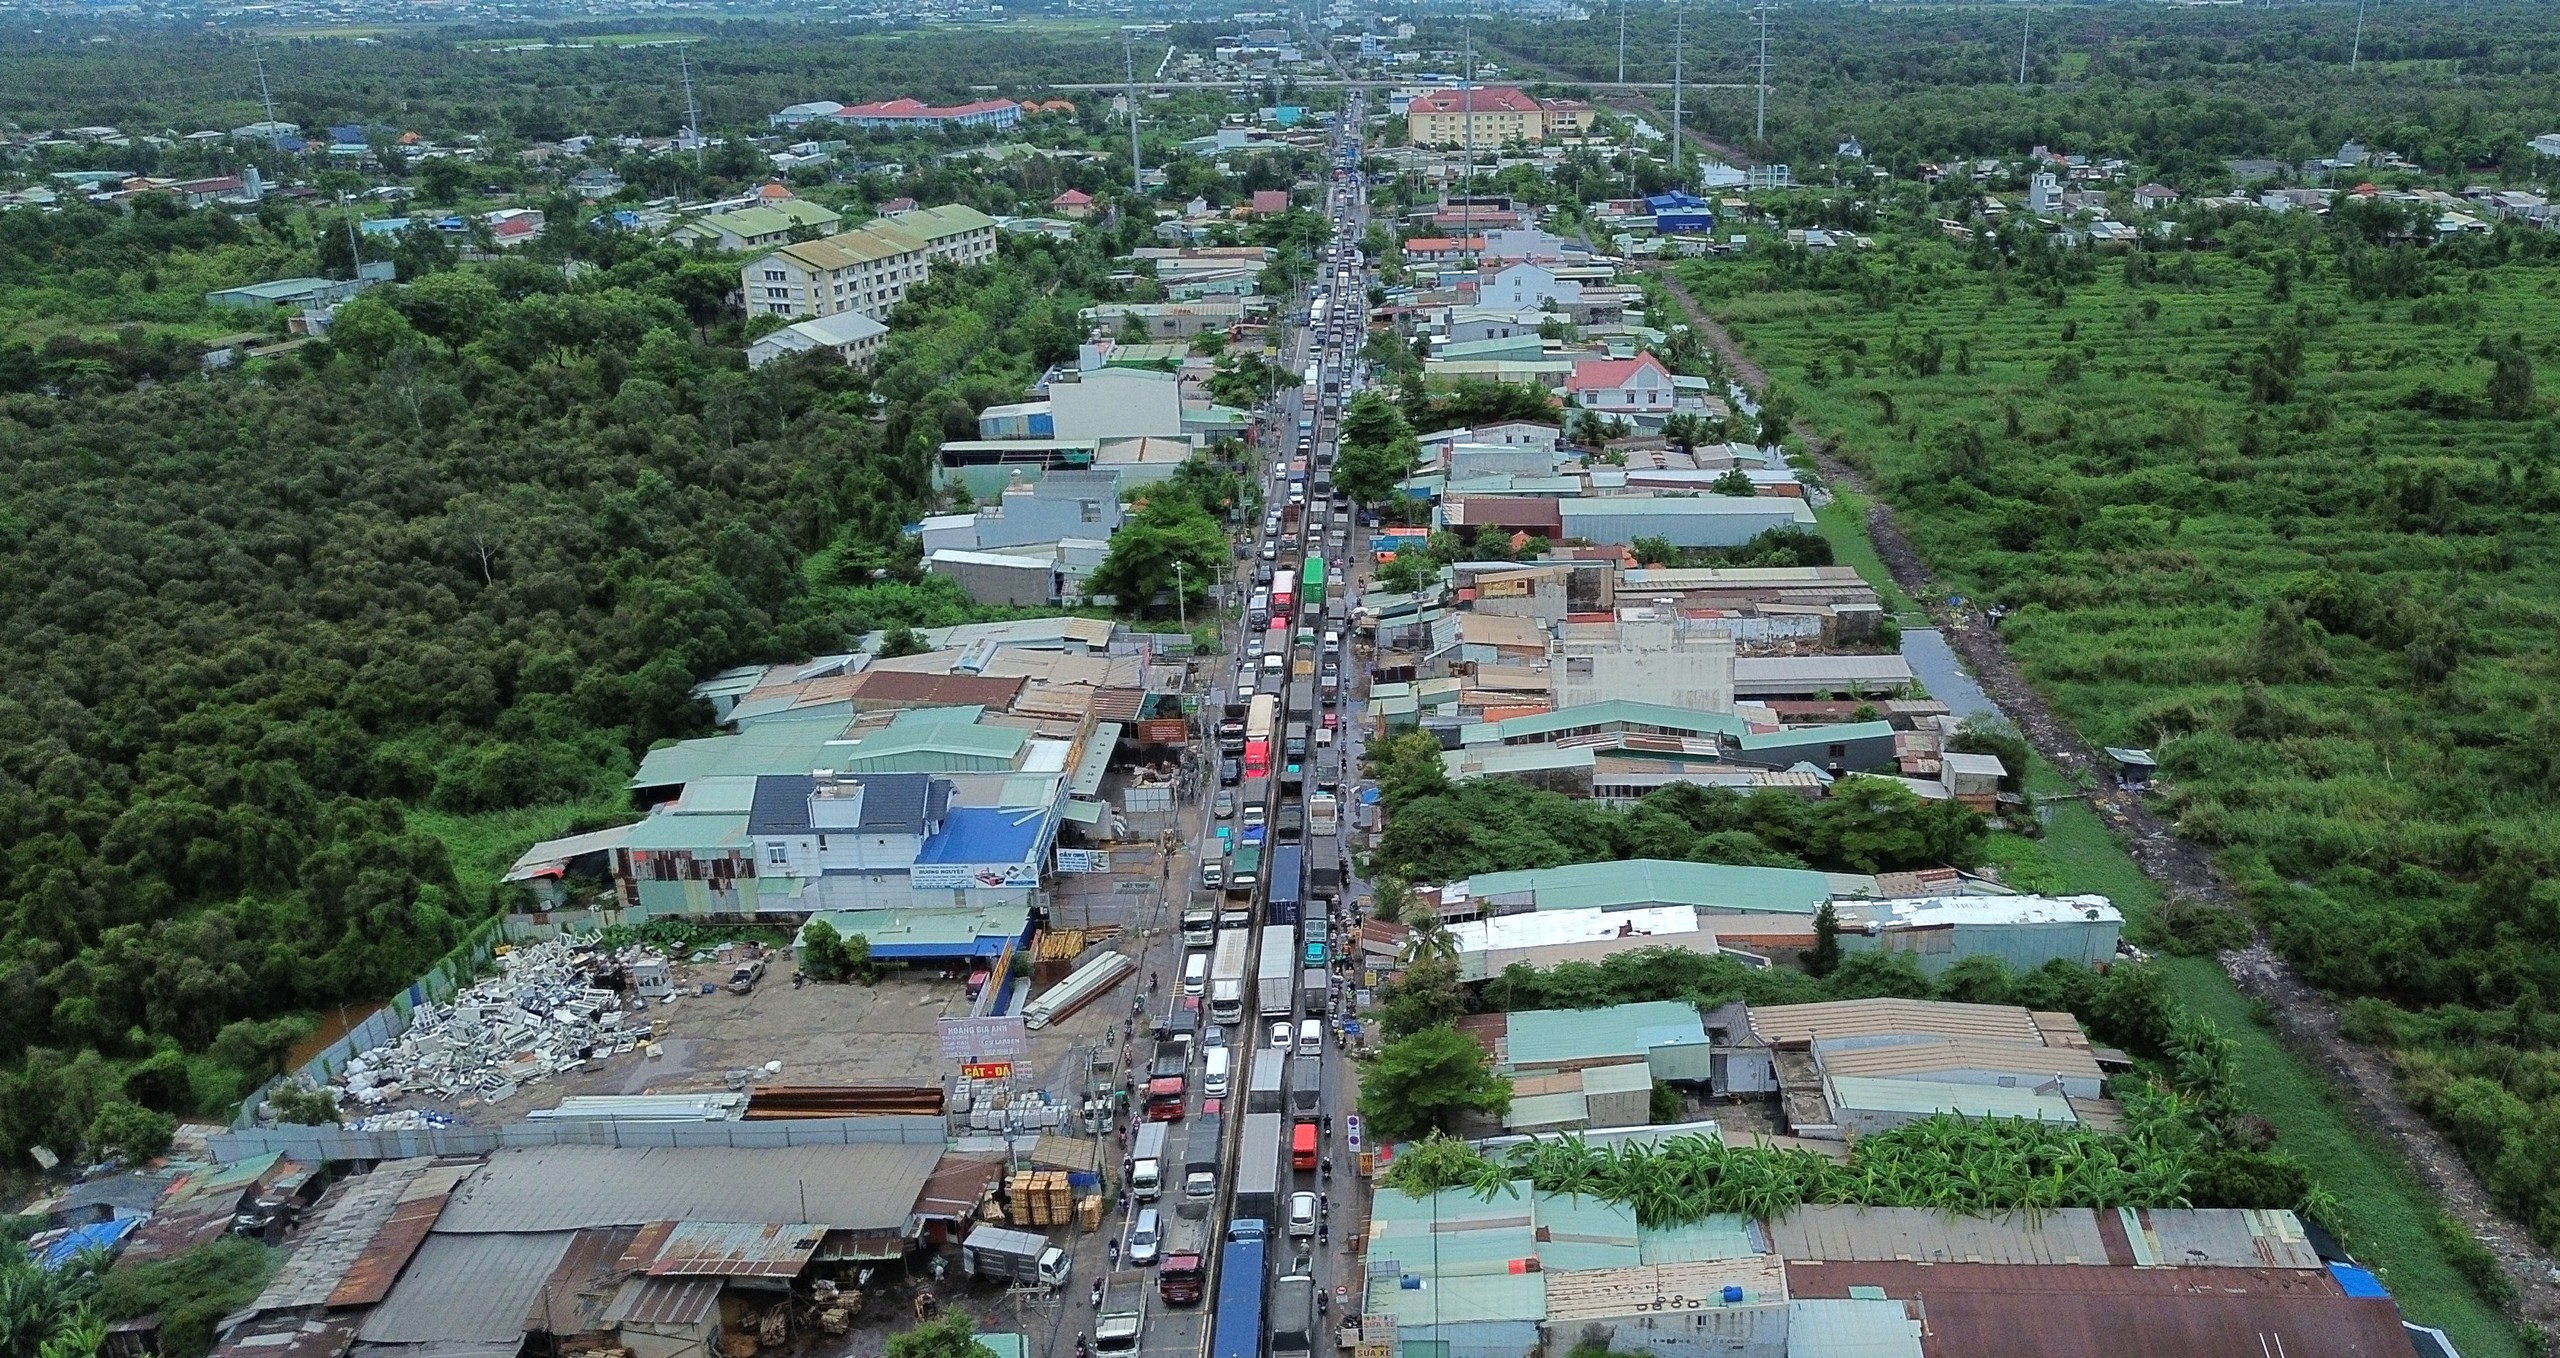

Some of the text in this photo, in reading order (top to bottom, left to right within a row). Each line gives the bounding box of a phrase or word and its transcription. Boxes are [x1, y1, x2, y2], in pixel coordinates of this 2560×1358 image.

[976, 1025, 990, 1034] GIA
[991, 1024, 1008, 1033] ANH
[964, 1065, 985, 1077] CÁT
[1380, 1348, 1391, 1357] XE
